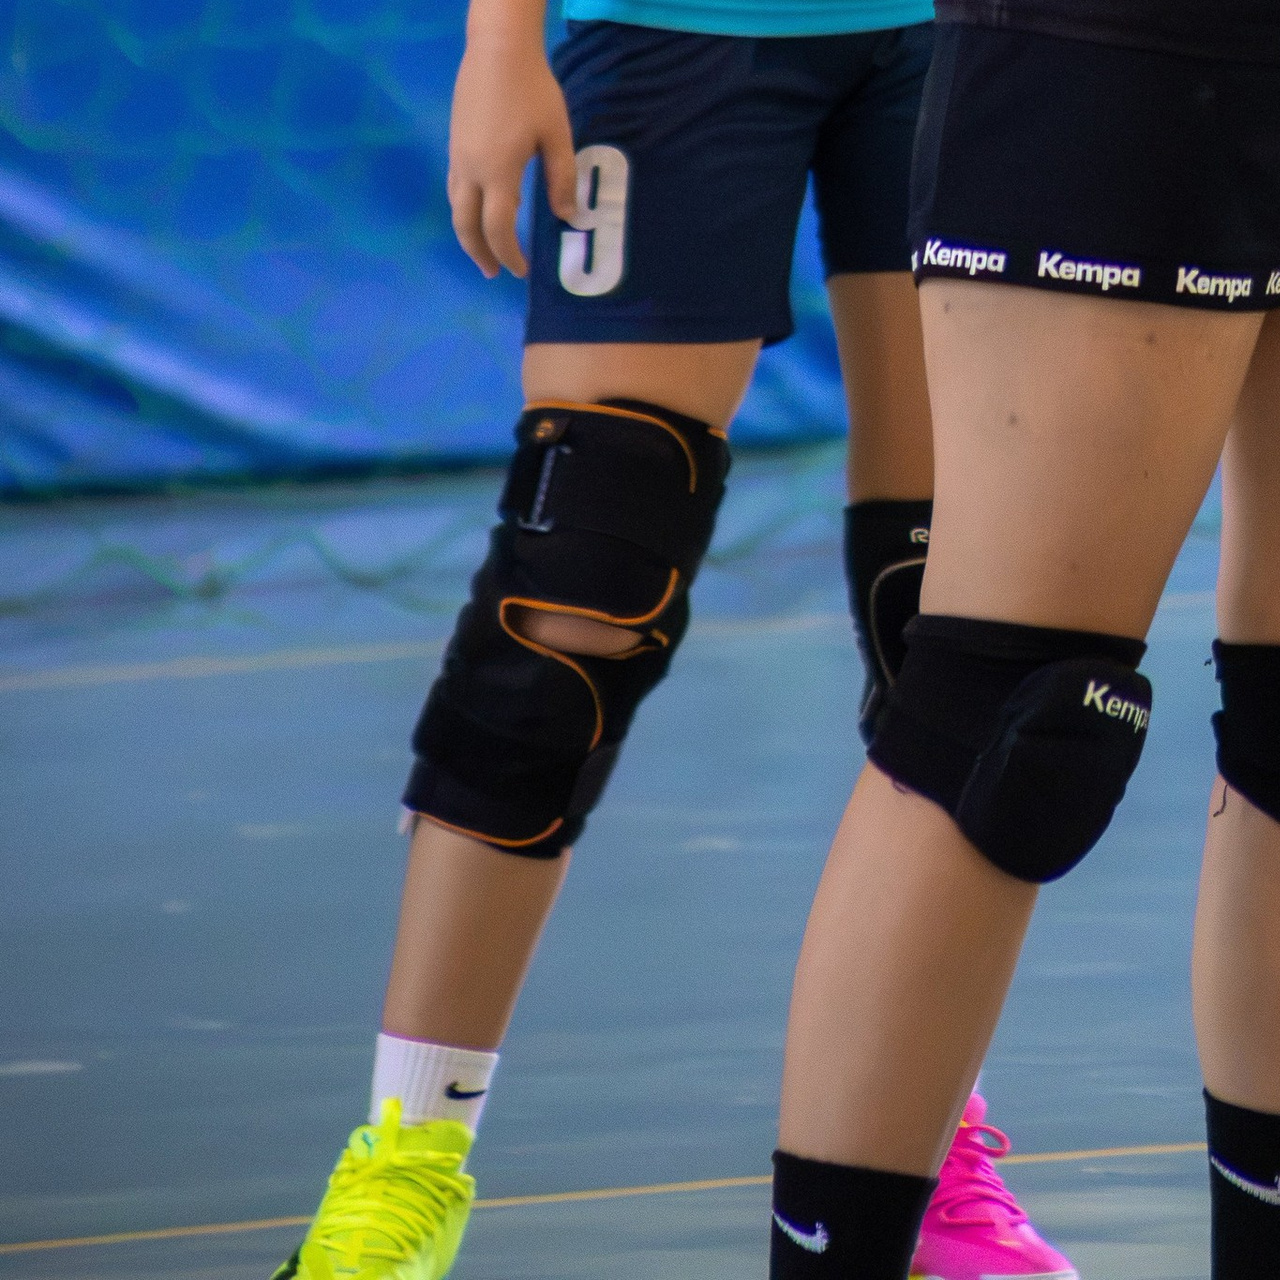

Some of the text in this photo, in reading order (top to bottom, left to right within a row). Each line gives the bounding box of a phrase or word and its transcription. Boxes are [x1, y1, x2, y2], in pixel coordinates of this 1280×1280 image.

[559, 144, 629, 298] 9
[923, 239, 1006, 276] Kempa
[1038, 251, 1141, 291] Kempa
[1176, 266, 1252, 304] Kempa
